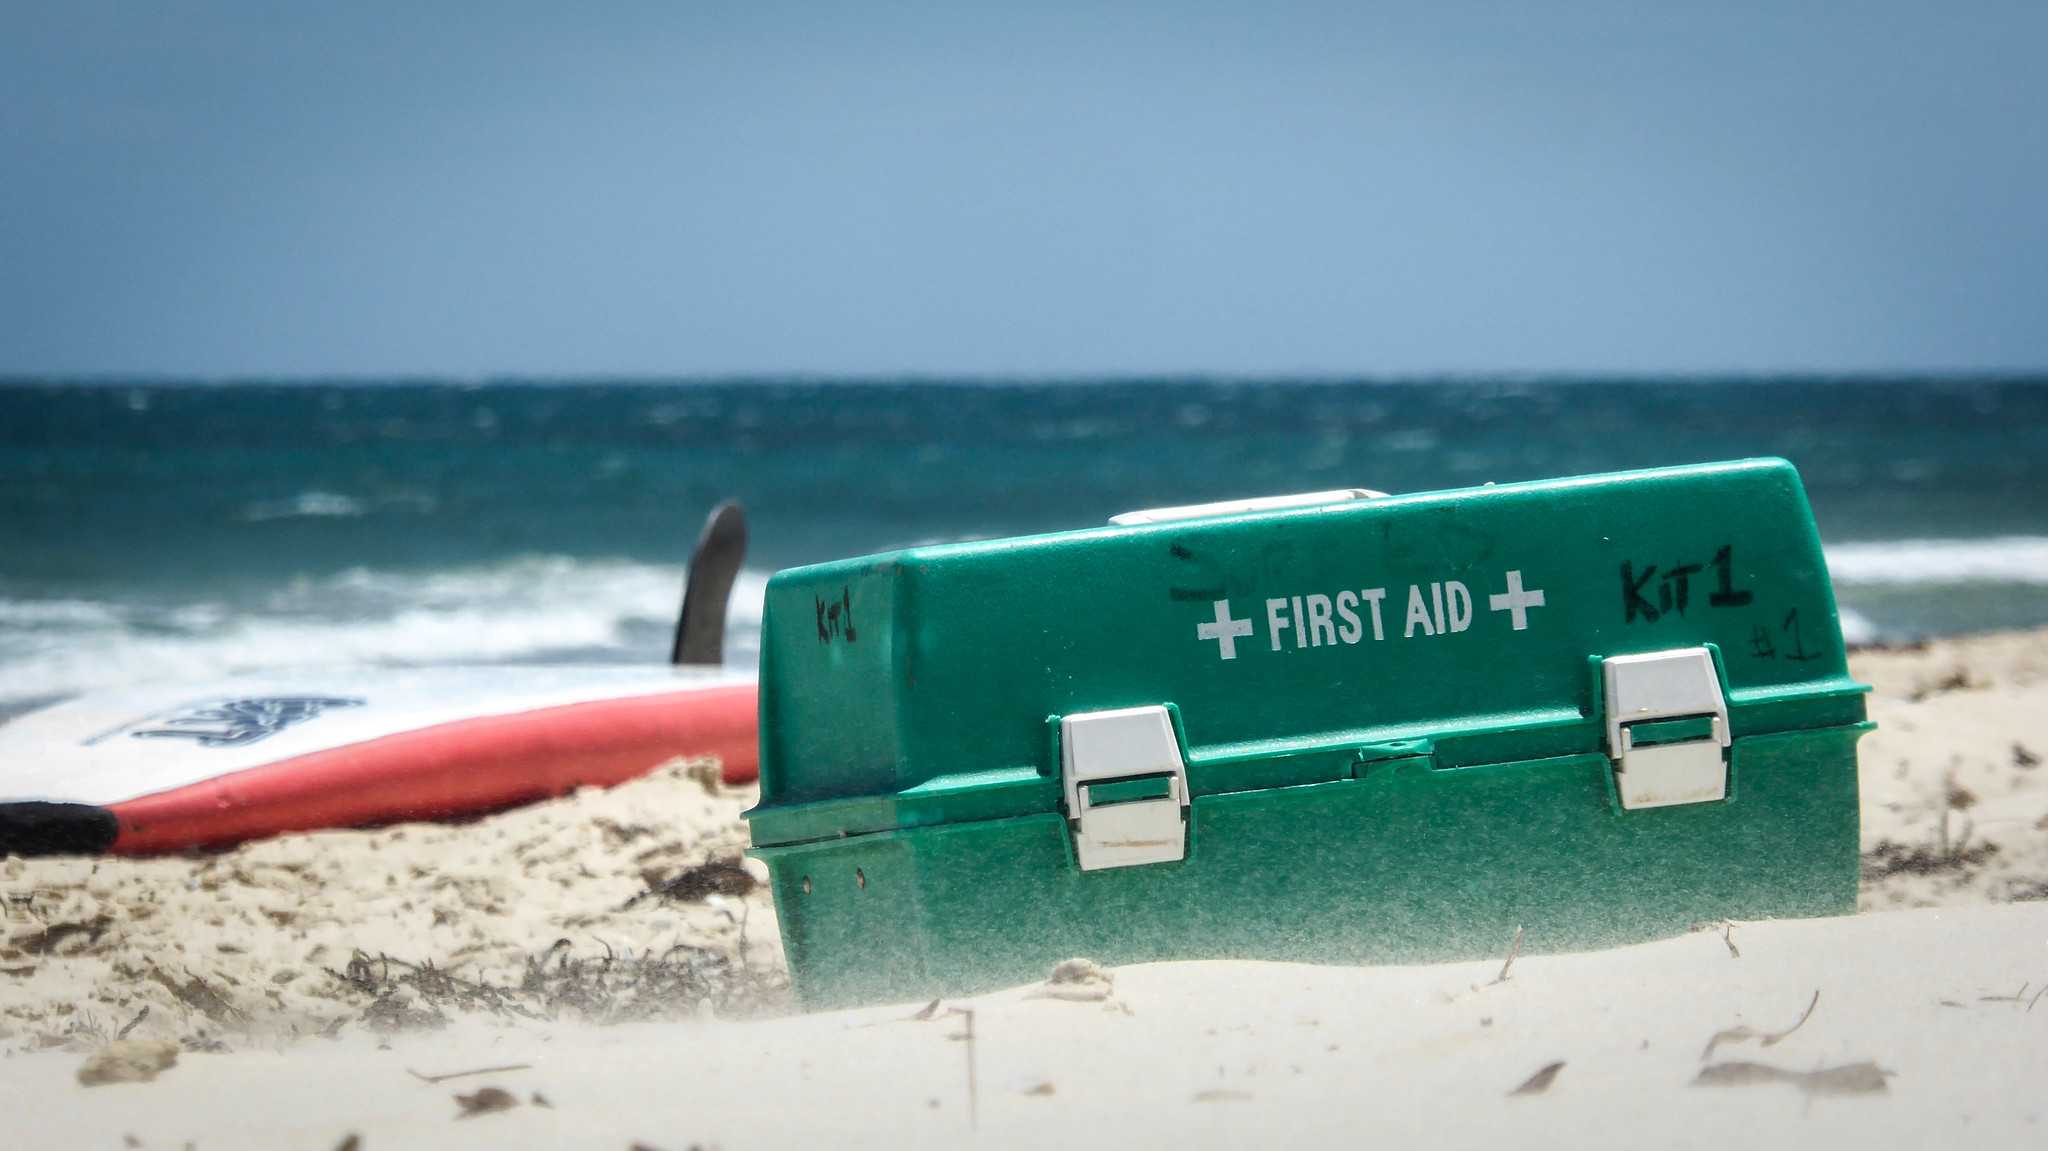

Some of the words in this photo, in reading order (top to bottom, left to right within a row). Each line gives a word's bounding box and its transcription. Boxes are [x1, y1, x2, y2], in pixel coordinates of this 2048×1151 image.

[1708, 544, 1754, 607] 1
[843, 585, 857, 643] 1
[1265, 587, 1386, 651] FIRST
[1404, 580, 1473, 638] AID
